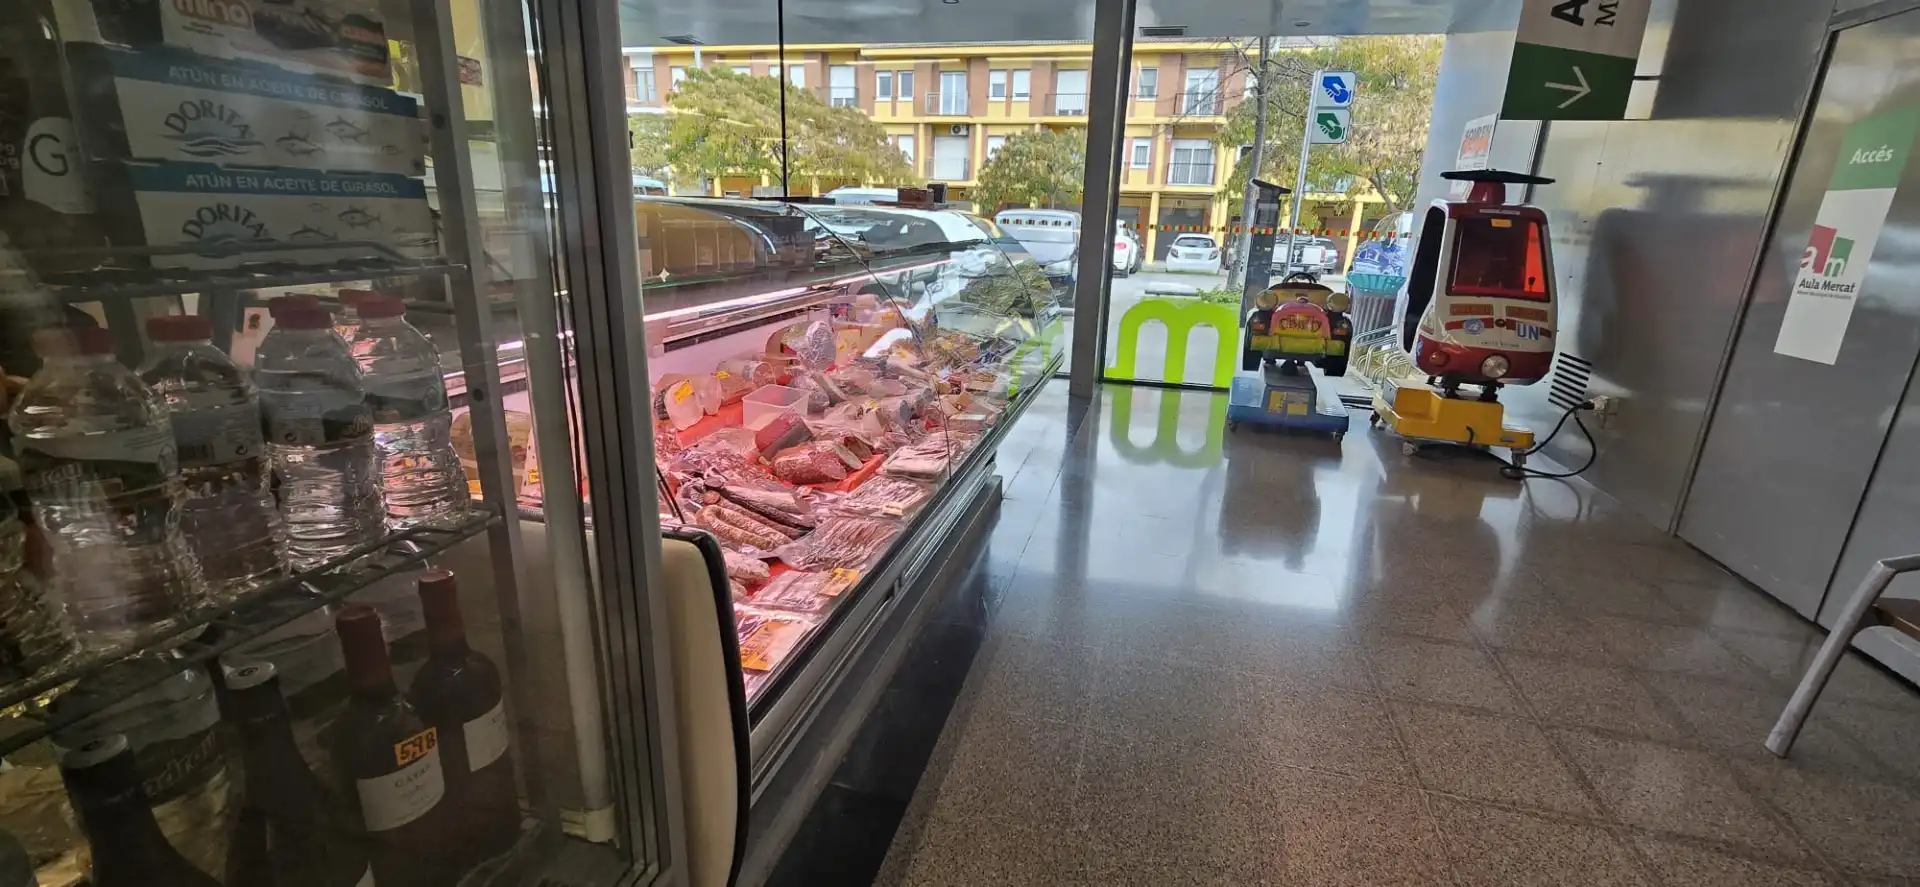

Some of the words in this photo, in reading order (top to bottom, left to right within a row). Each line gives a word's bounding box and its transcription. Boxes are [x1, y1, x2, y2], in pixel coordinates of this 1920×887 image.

[221, 74, 244, 89] EN
[248, 79, 305, 98] ACEITE
[308, 87, 327, 101] DE
[163, 99, 250, 139] DORITA
[1849, 144, 1894, 165] Accés
[185, 171, 232, 190] ATÚN
[236, 175, 259, 190] EN
[263, 177, 317, 192] ACEITE
[320, 179, 339, 193] DE
[341, 180, 399, 194] GIRASOL
[181, 203, 265, 237] DORITA
[1798, 278, 1820, 290] Aula
[1820, 280, 1857, 294] Mercat
[1517, 323, 1540, 341] UN
